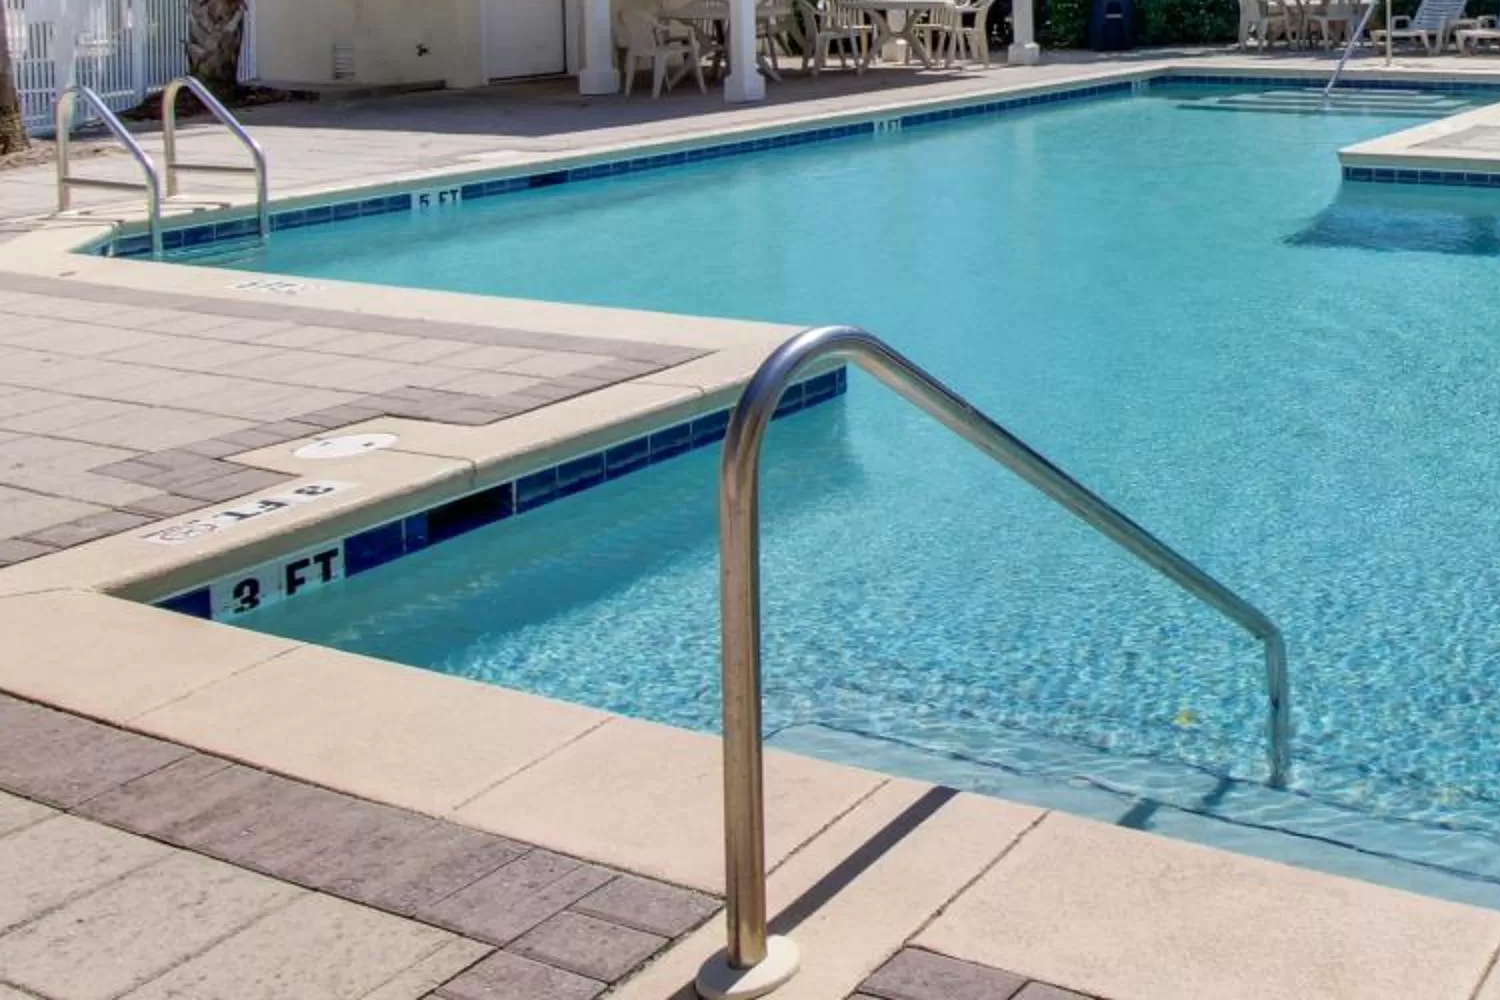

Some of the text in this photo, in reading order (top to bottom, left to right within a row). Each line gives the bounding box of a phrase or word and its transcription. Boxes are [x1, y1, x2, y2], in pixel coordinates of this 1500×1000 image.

[439, 189, 459, 204] FT
[232, 548, 339, 614] 3 FT
